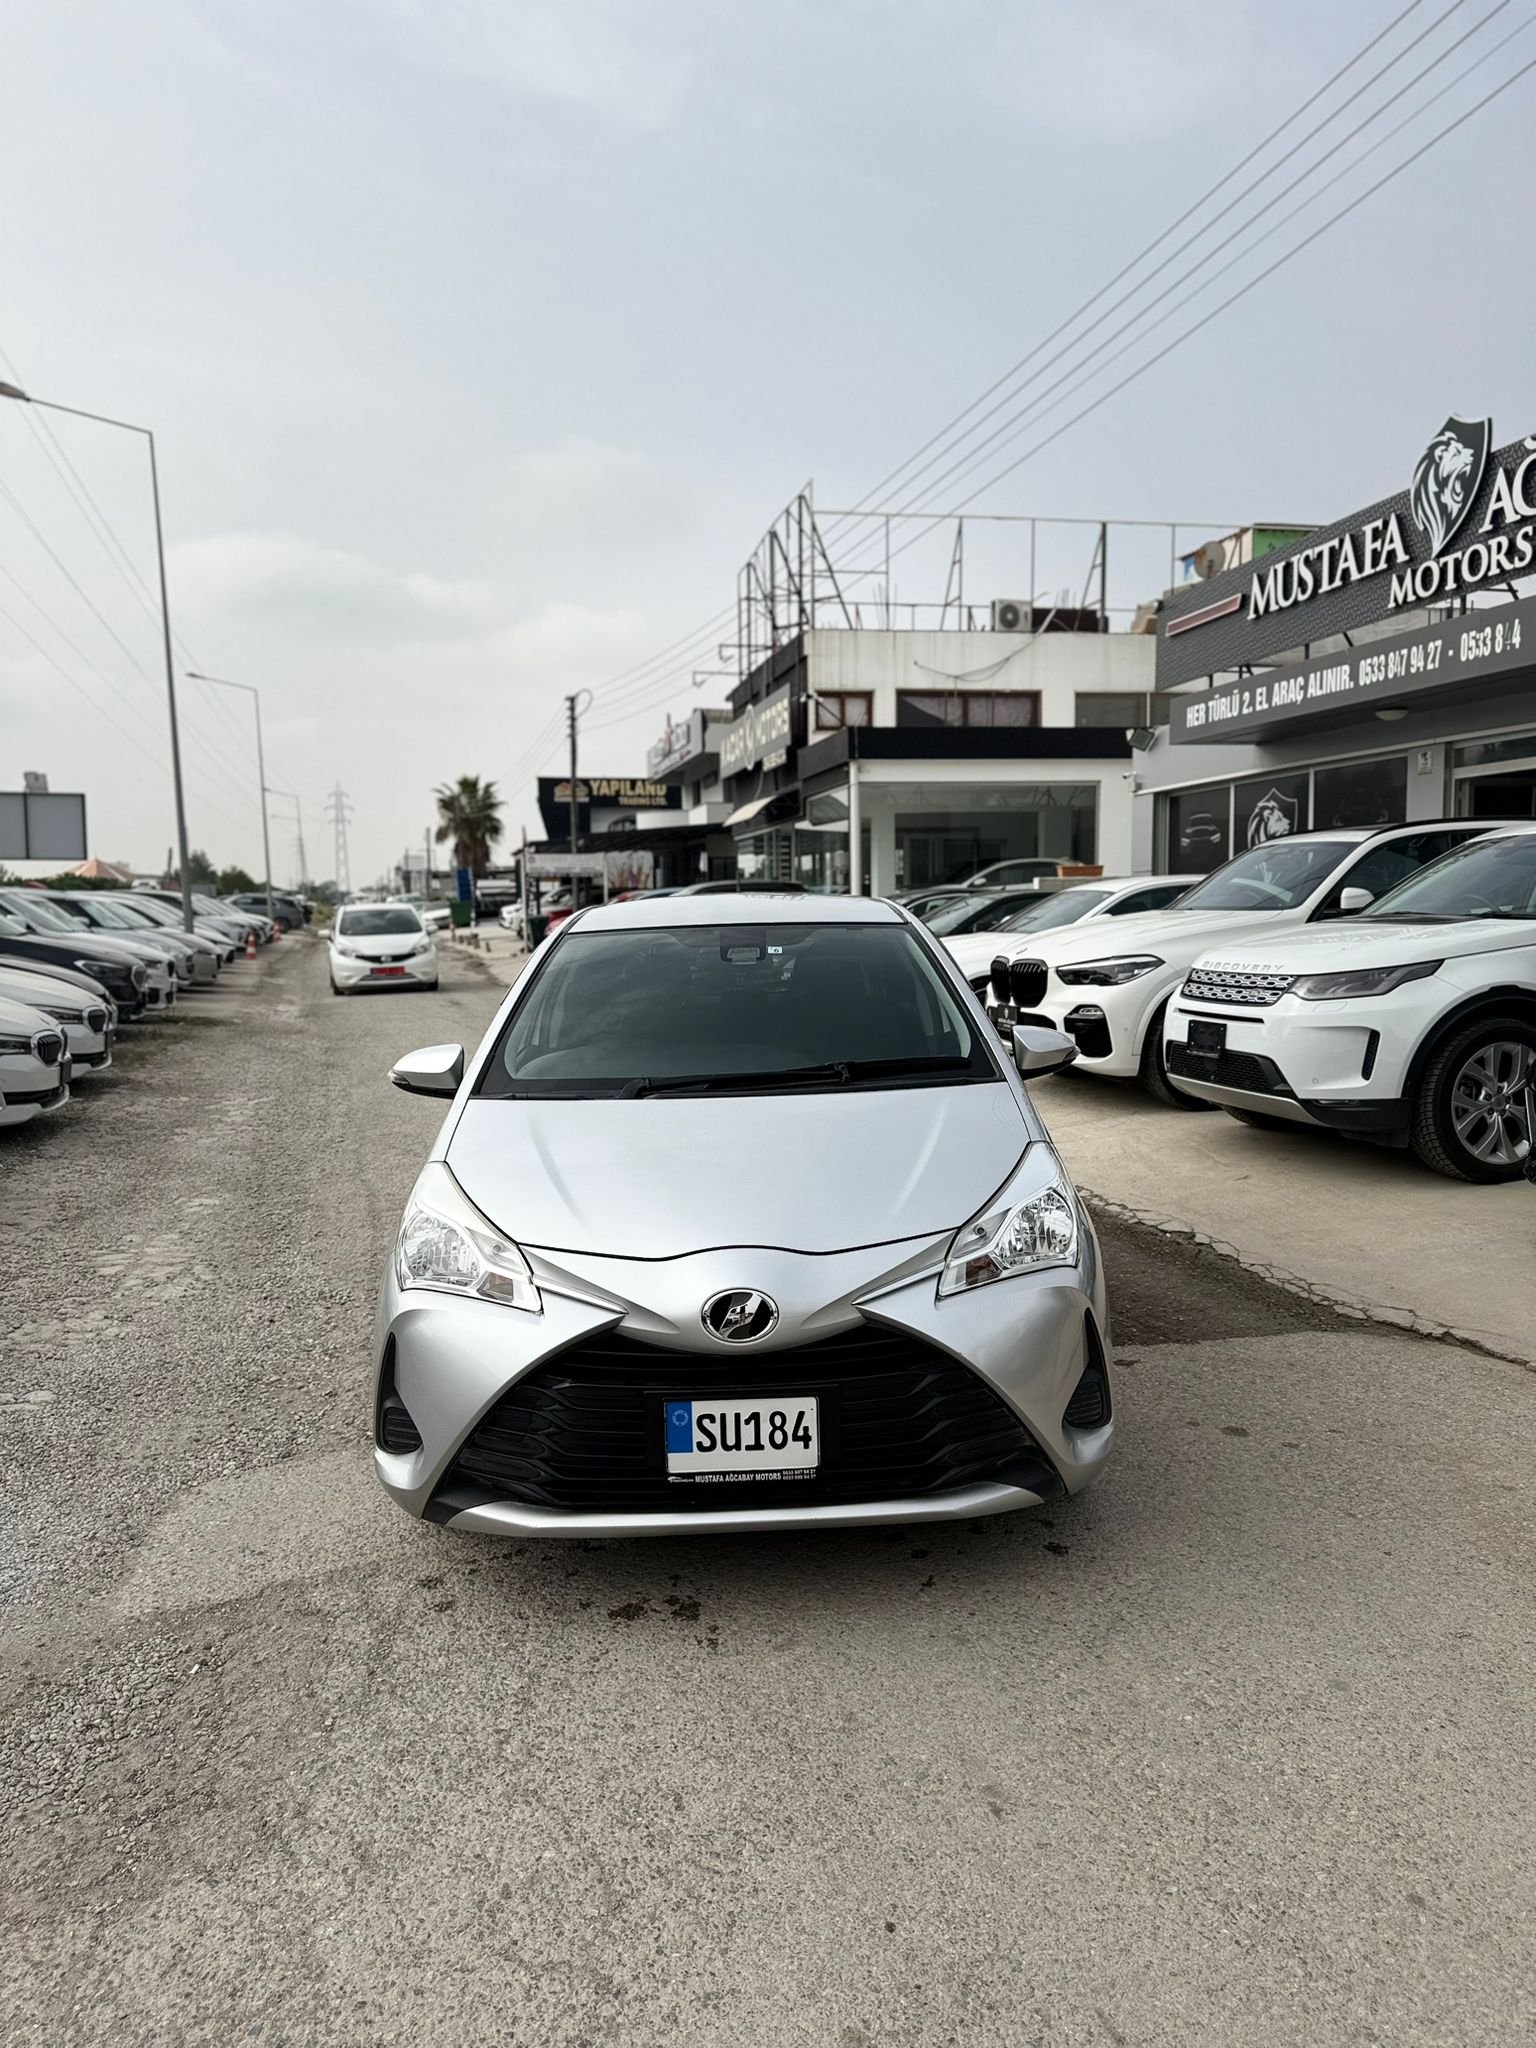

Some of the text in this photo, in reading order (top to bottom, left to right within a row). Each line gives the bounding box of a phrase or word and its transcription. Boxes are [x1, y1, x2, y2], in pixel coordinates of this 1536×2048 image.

[1247, 512, 1410, 620] MUSTAFA
[1387, 526, 1533, 608] MOTORS
[1186, 702, 1206, 728] HER
[1208, 689, 1240, 723] TÜRLÜ
[1242, 691, 1253, 715] 2.
[1255, 686, 1269, 711] EL
[1272, 676, 1305, 705] ARAÇ
[1307, 664, 1354, 699] ALINIR.
[1359, 654, 1386, 686] 0533
[1387, 648, 1408, 679] 847
[1410, 644, 1424, 674] 94
[1426, 639, 1442, 670] 27
[1460, 626, 1492, 662] 0533
[1202, 960, 1284, 971] DISCOVERY
[696, 1411, 812, 1452] SU184
[695, 1475, 724, 1483] MUSTAFA
[755, 1472, 782, 1481] MOTORS
